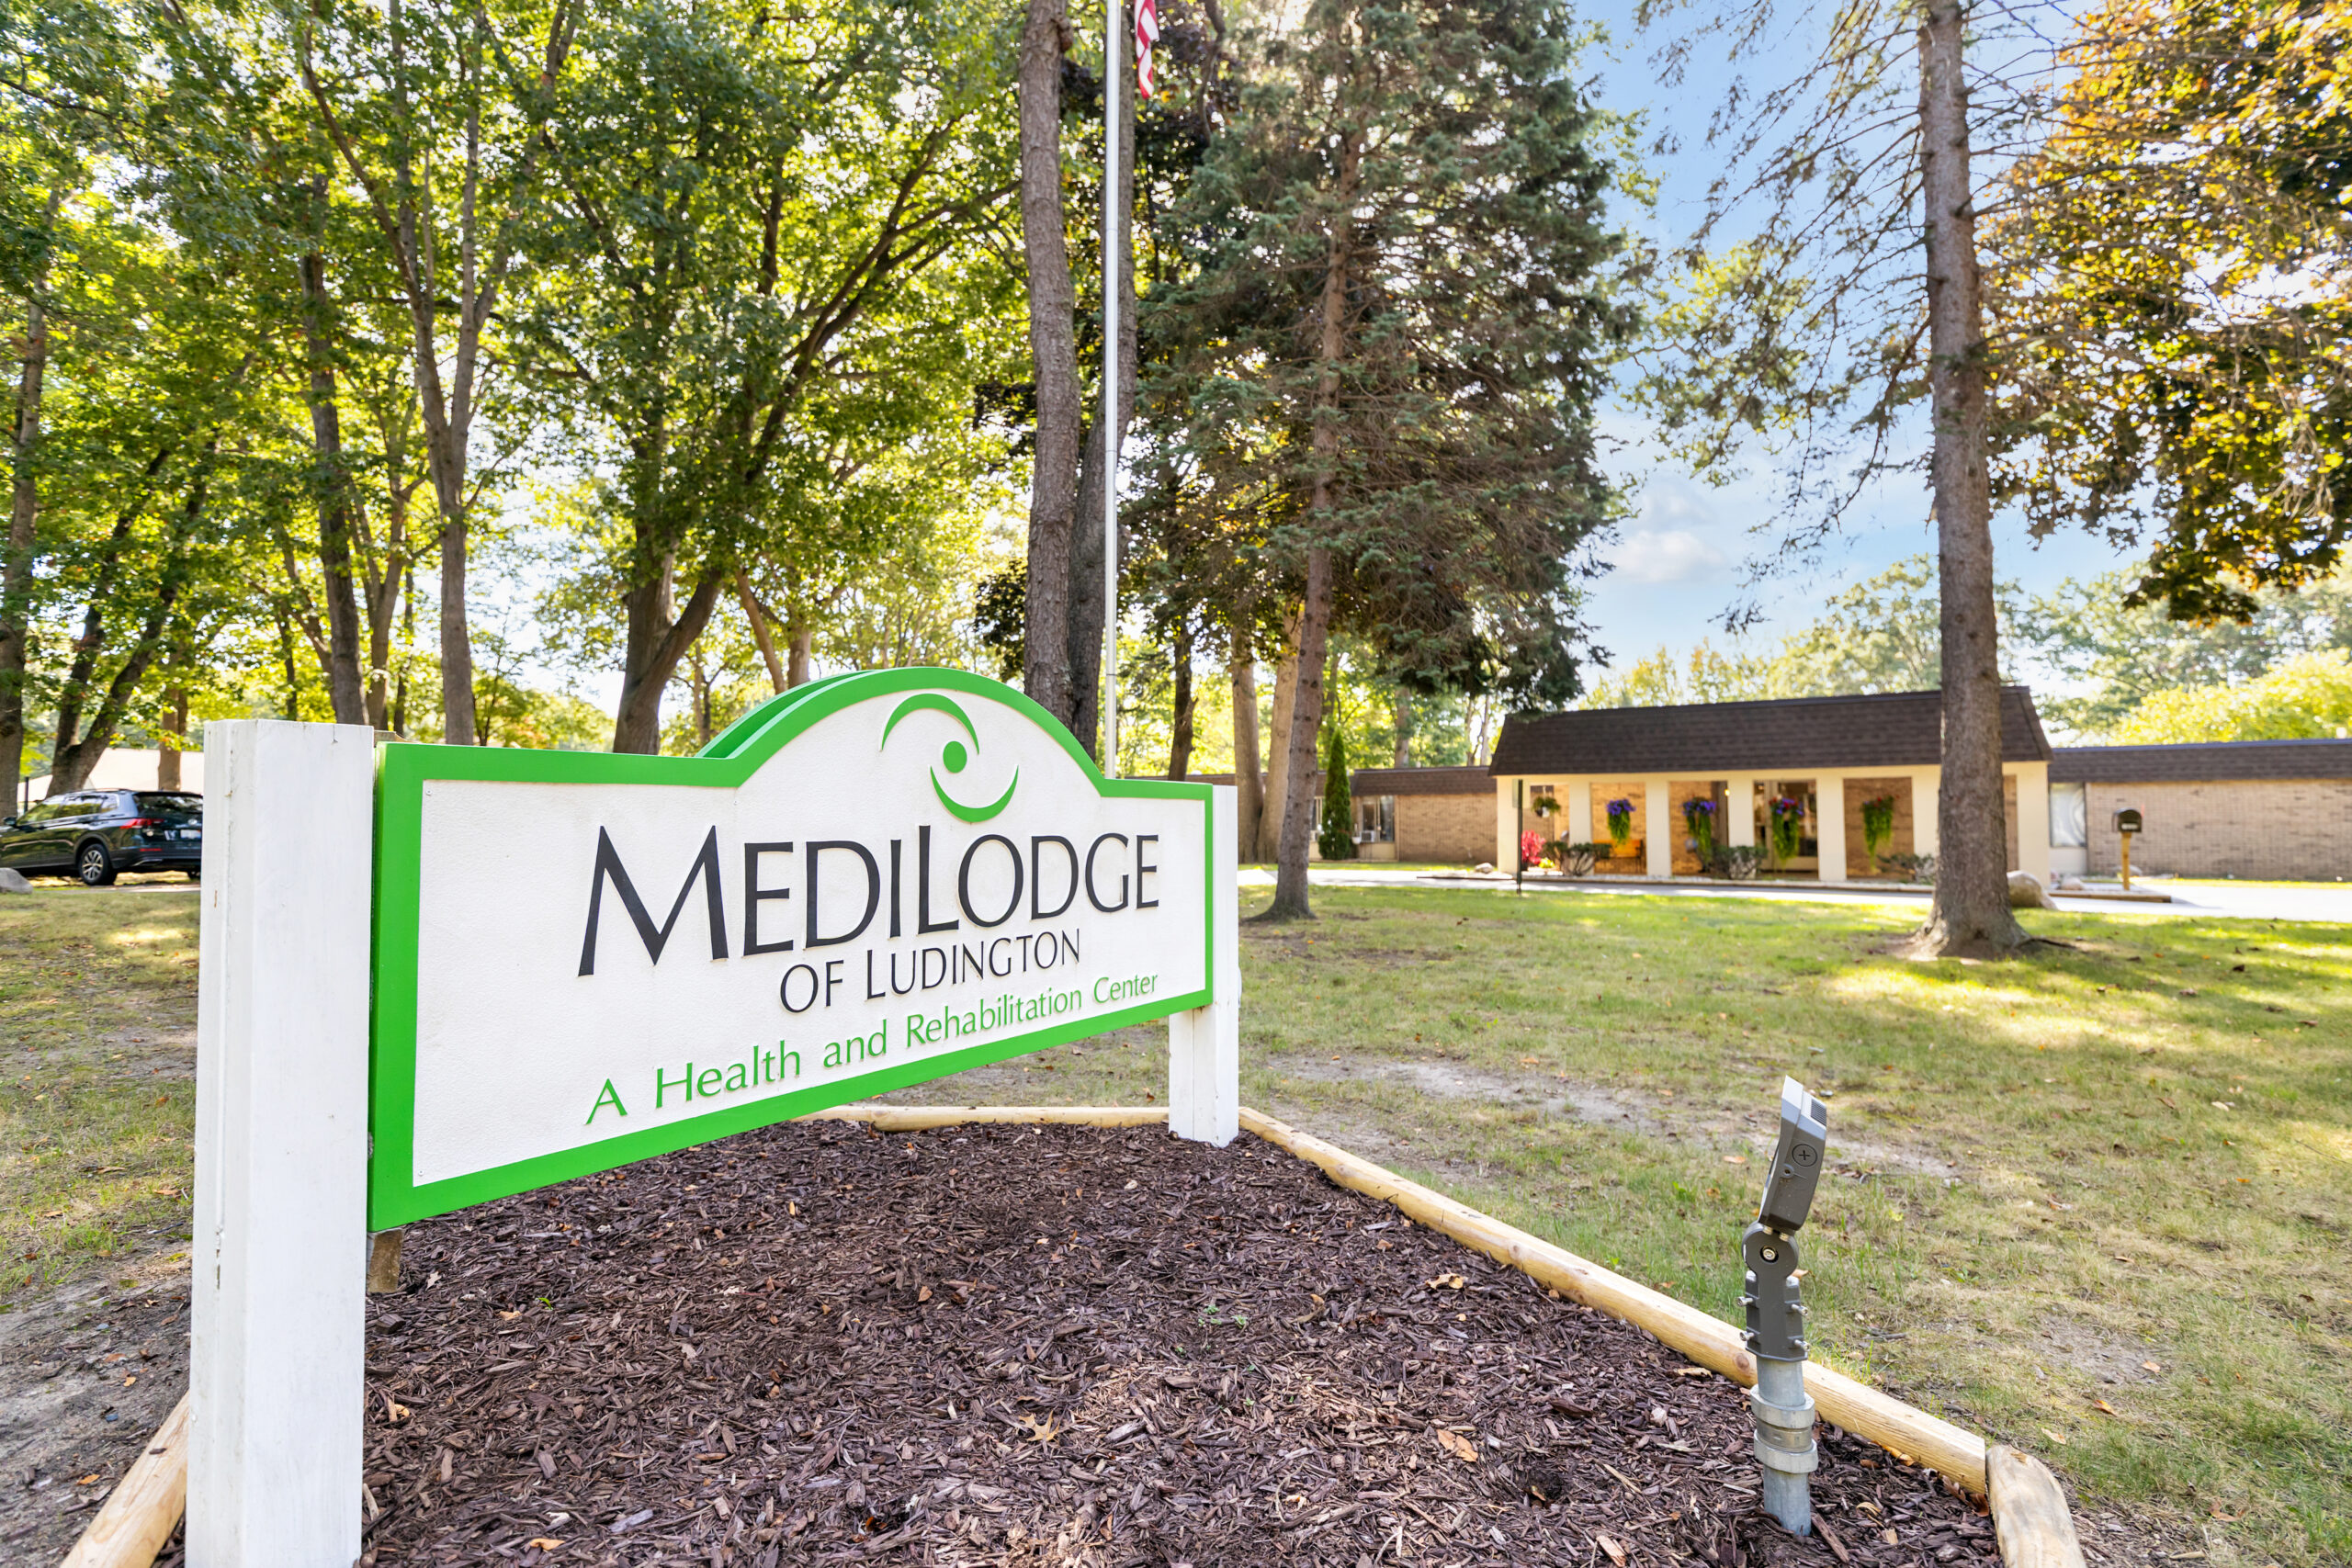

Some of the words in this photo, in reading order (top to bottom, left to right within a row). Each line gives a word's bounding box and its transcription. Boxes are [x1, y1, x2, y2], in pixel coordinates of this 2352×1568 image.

[578, 825, 1159, 977] MEDILODGE
[780, 960, 844, 1013] OF
[865, 929, 1080, 1001] LUDINGTON
[584, 1077, 628, 1126] A
[655, 1040, 801, 1109] Health
[822, 1020, 888, 1068] and
[906, 985, 1083, 1049] Rehabilitation
[1092, 970, 1159, 1005] Center
